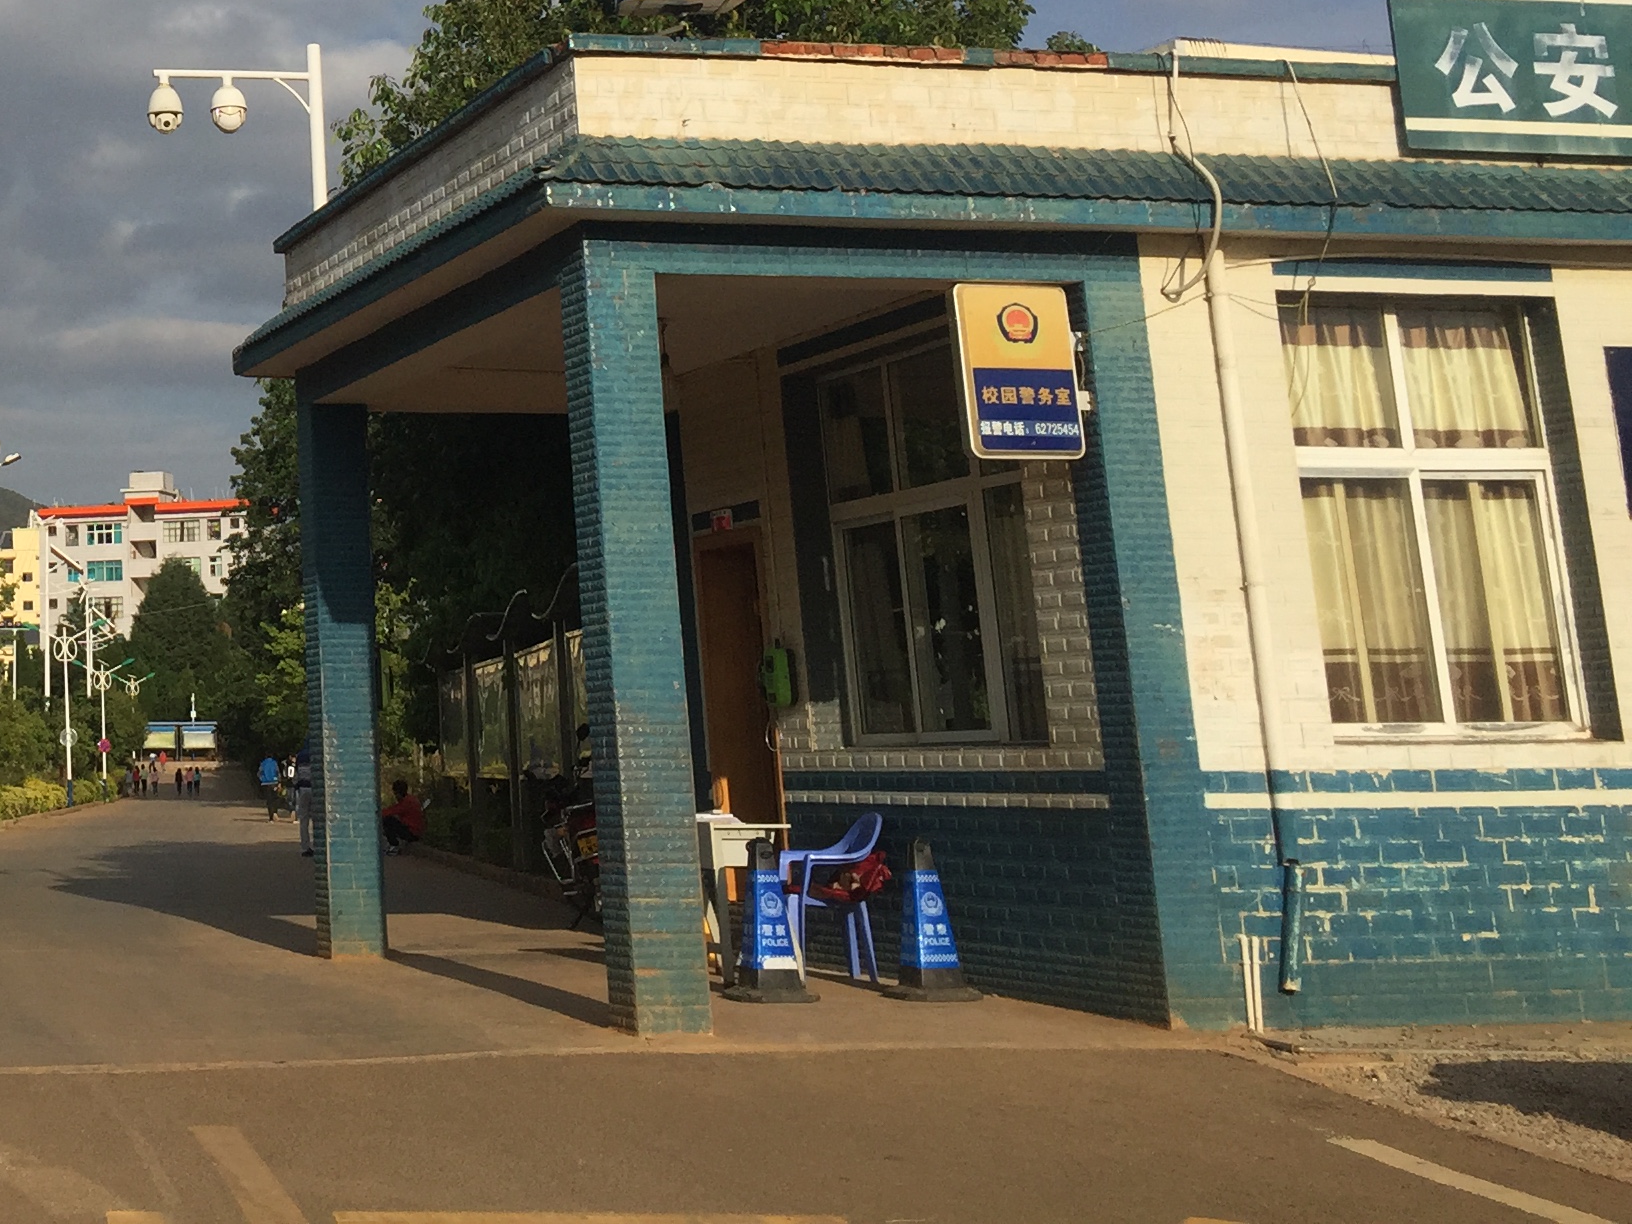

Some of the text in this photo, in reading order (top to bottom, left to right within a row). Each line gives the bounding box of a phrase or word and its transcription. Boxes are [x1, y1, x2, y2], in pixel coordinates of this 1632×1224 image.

[1434, 22, 1618, 119] 公安
[981, 386, 1072, 406] 校园警务室
[762, 938, 788, 946] POLICE
[924, 937, 950, 946] POLICE
